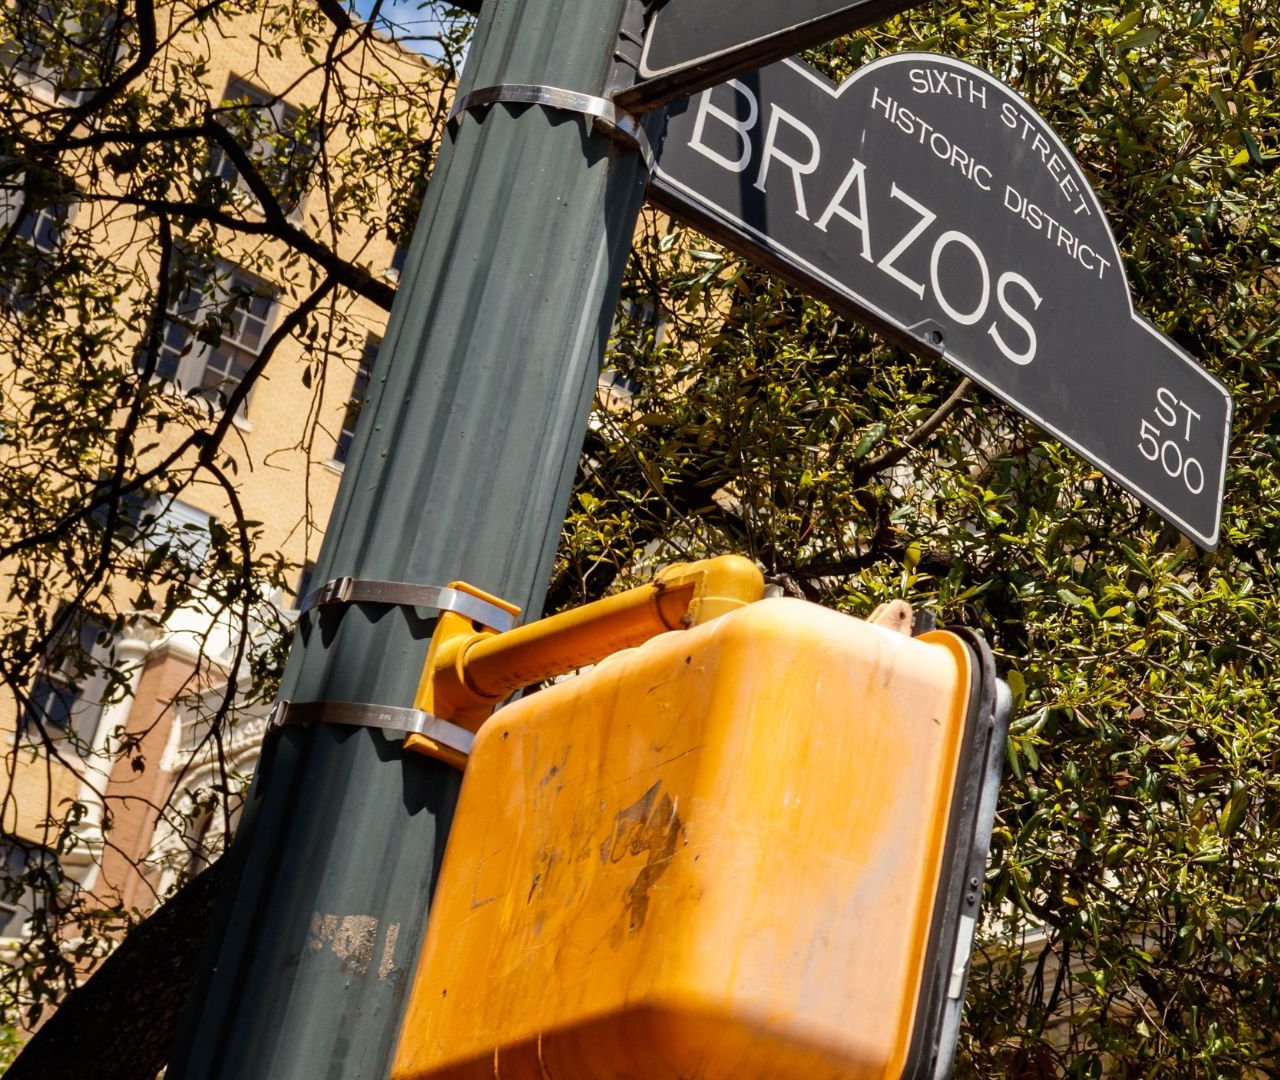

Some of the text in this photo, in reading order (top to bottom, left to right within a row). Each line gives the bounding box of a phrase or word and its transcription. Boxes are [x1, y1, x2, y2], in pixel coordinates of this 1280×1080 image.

[870, 86, 1111, 280] HISTORIC DISTRICT
[908, 68, 1092, 217] SIXTH STREET
[686, 78, 1043, 366] BRAZOS
[1137, 418, 1205, 495] 500
[1153, 387, 1201, 442] ST
